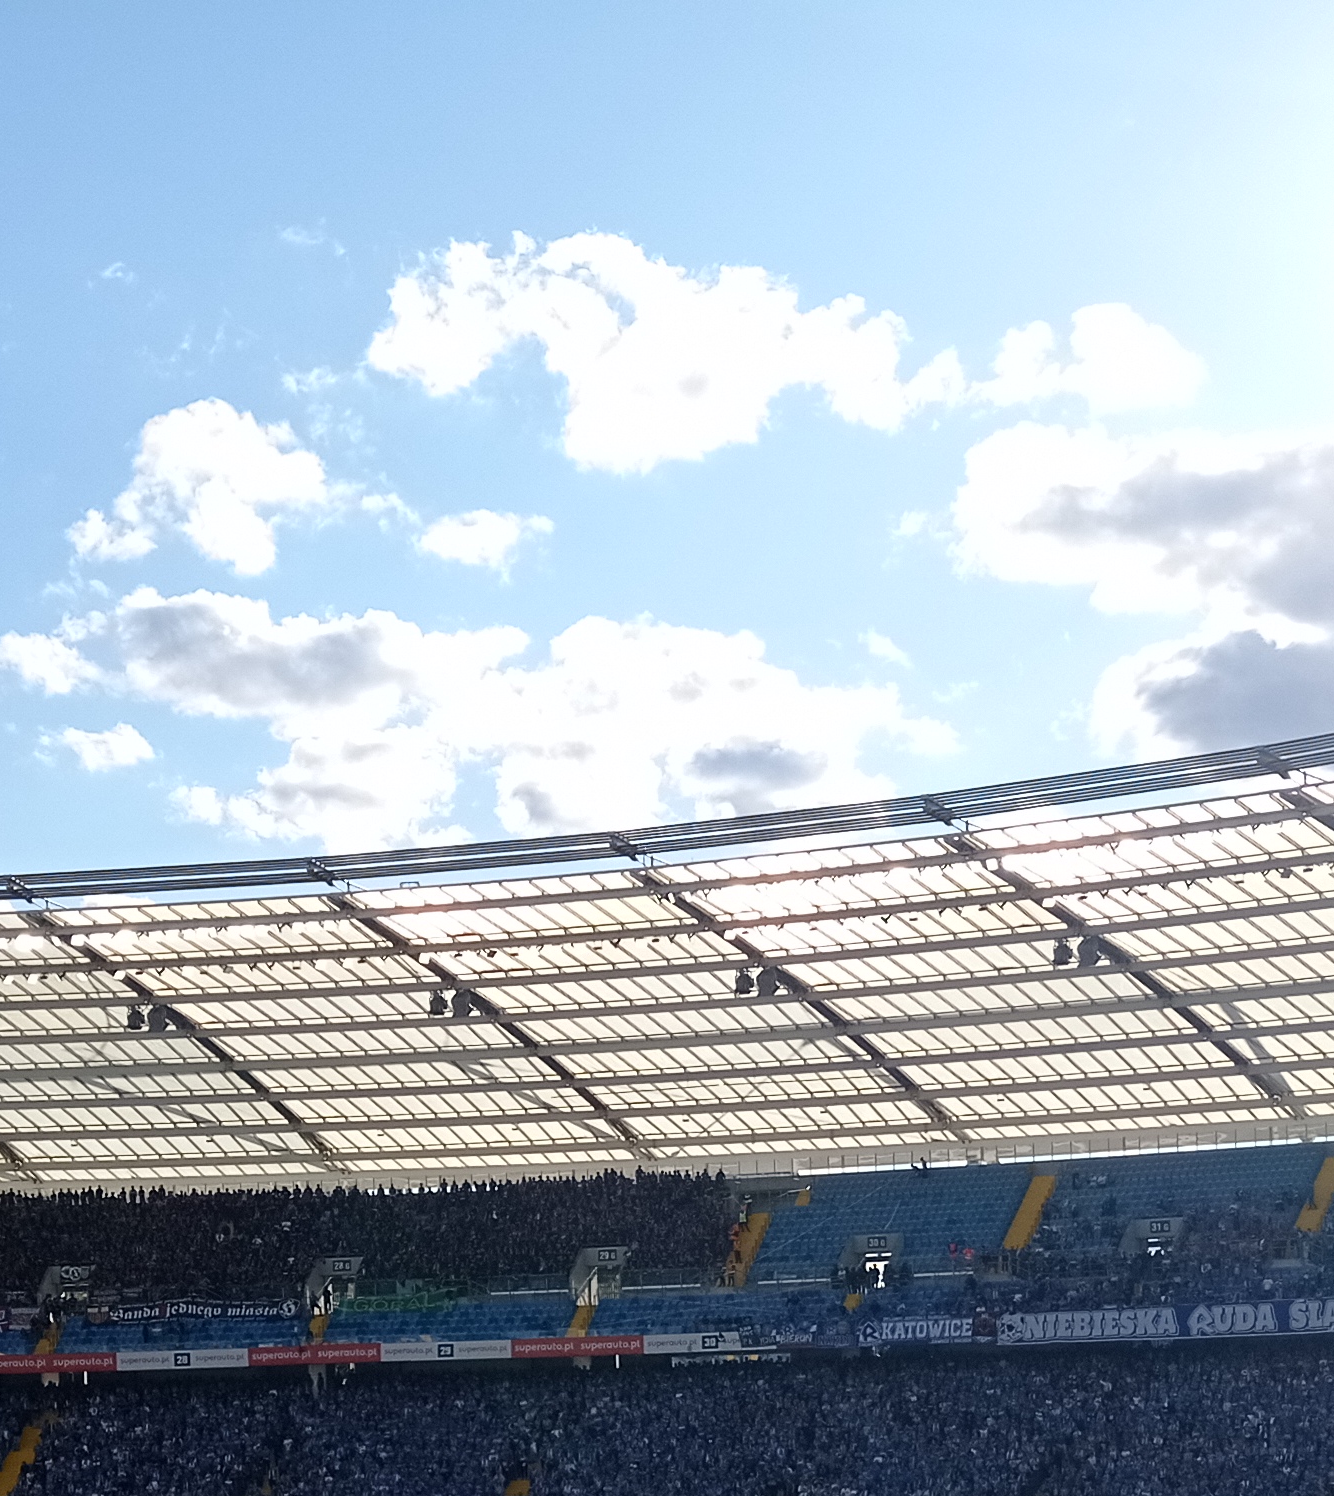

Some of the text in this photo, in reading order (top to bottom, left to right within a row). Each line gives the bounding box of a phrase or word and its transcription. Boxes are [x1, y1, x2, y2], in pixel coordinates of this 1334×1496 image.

[882, 1317, 973, 1341] KATOWICE
[1023, 1308, 1179, 1340] NIEBIESKA
[1188, 1303, 1277, 1336] RUDA
